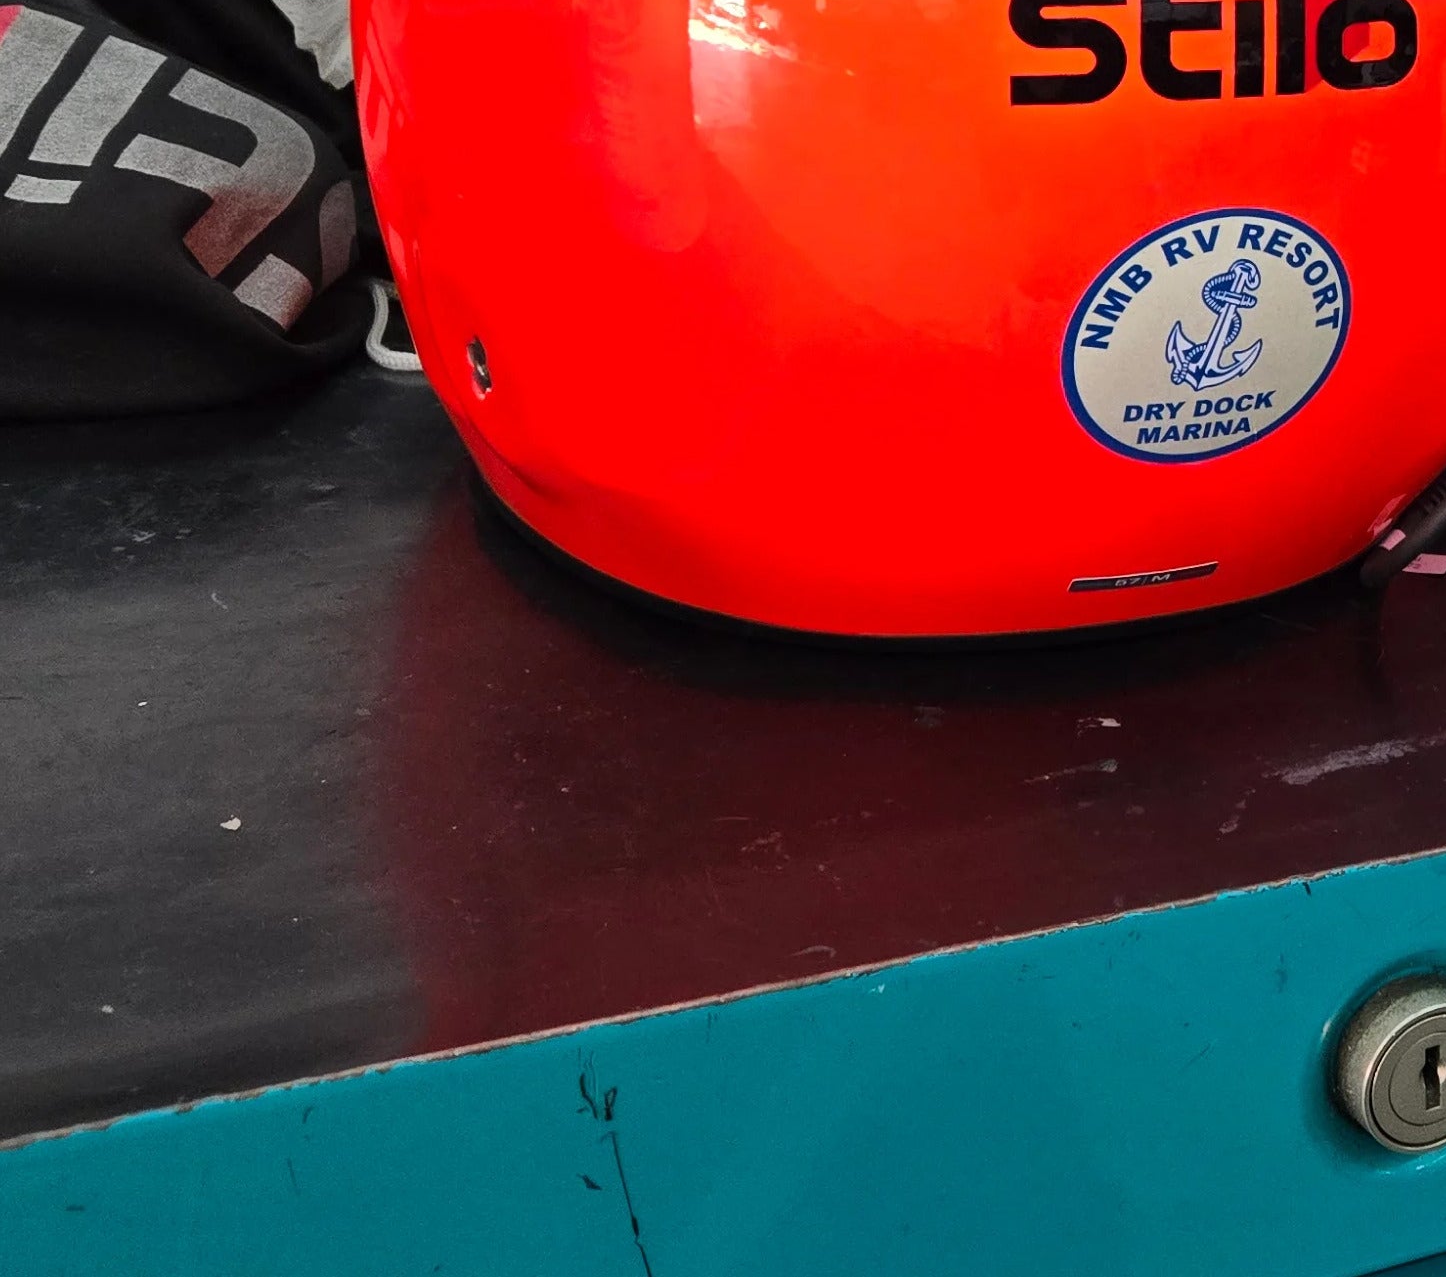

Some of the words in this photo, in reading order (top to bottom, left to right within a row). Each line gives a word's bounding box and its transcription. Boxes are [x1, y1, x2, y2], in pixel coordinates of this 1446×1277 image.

[1079, 262, 1154, 351] NMB
[1160, 224, 1221, 267] RV
[1236, 222, 1341, 331] RESORT
[1122, 400, 1186, 423] DRY
[1193, 389, 1277, 418] DOCK
[1135, 416, 1252, 445] MARINA
[1151, 573, 1171, 582] M
